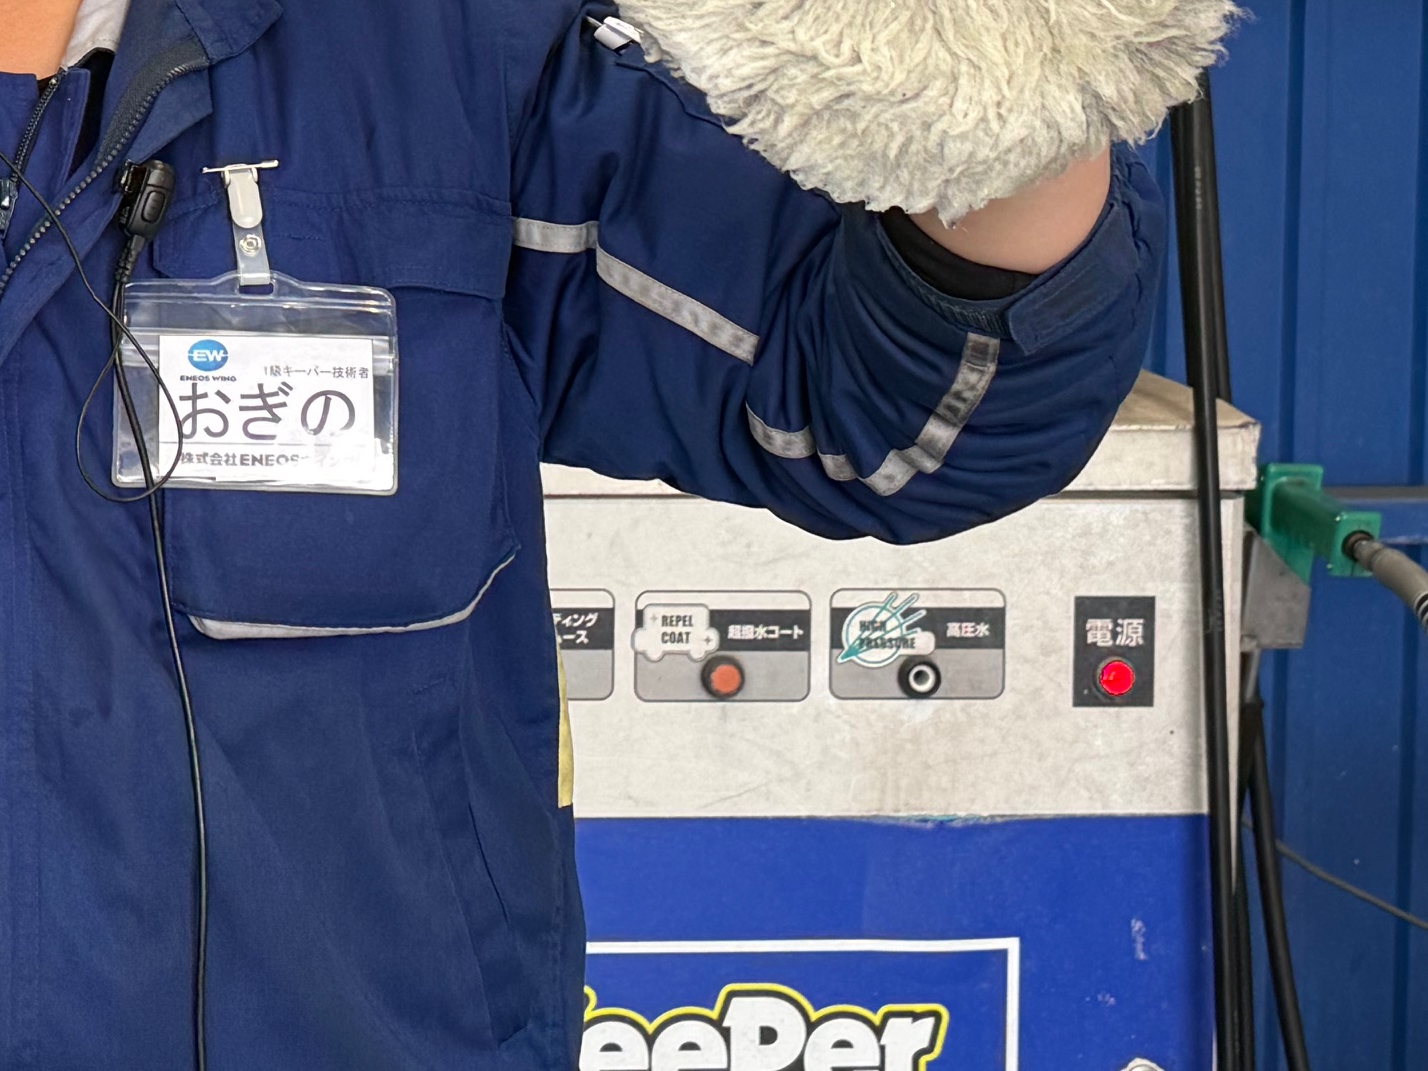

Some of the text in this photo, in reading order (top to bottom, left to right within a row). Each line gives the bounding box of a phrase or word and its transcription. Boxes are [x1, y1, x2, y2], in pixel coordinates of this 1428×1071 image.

[179, 374, 210, 382] ENEOS
[178, 381, 356, 441] おぎの
[660, 615, 694, 627] REPEL
[557, 630, 589, 644] ース
[660, 631, 692, 644] COAT
[946, 622, 990, 638] 高圧水
[1085, 618, 1145, 647] 電源
[579, 991, 940, 1071] eePer
